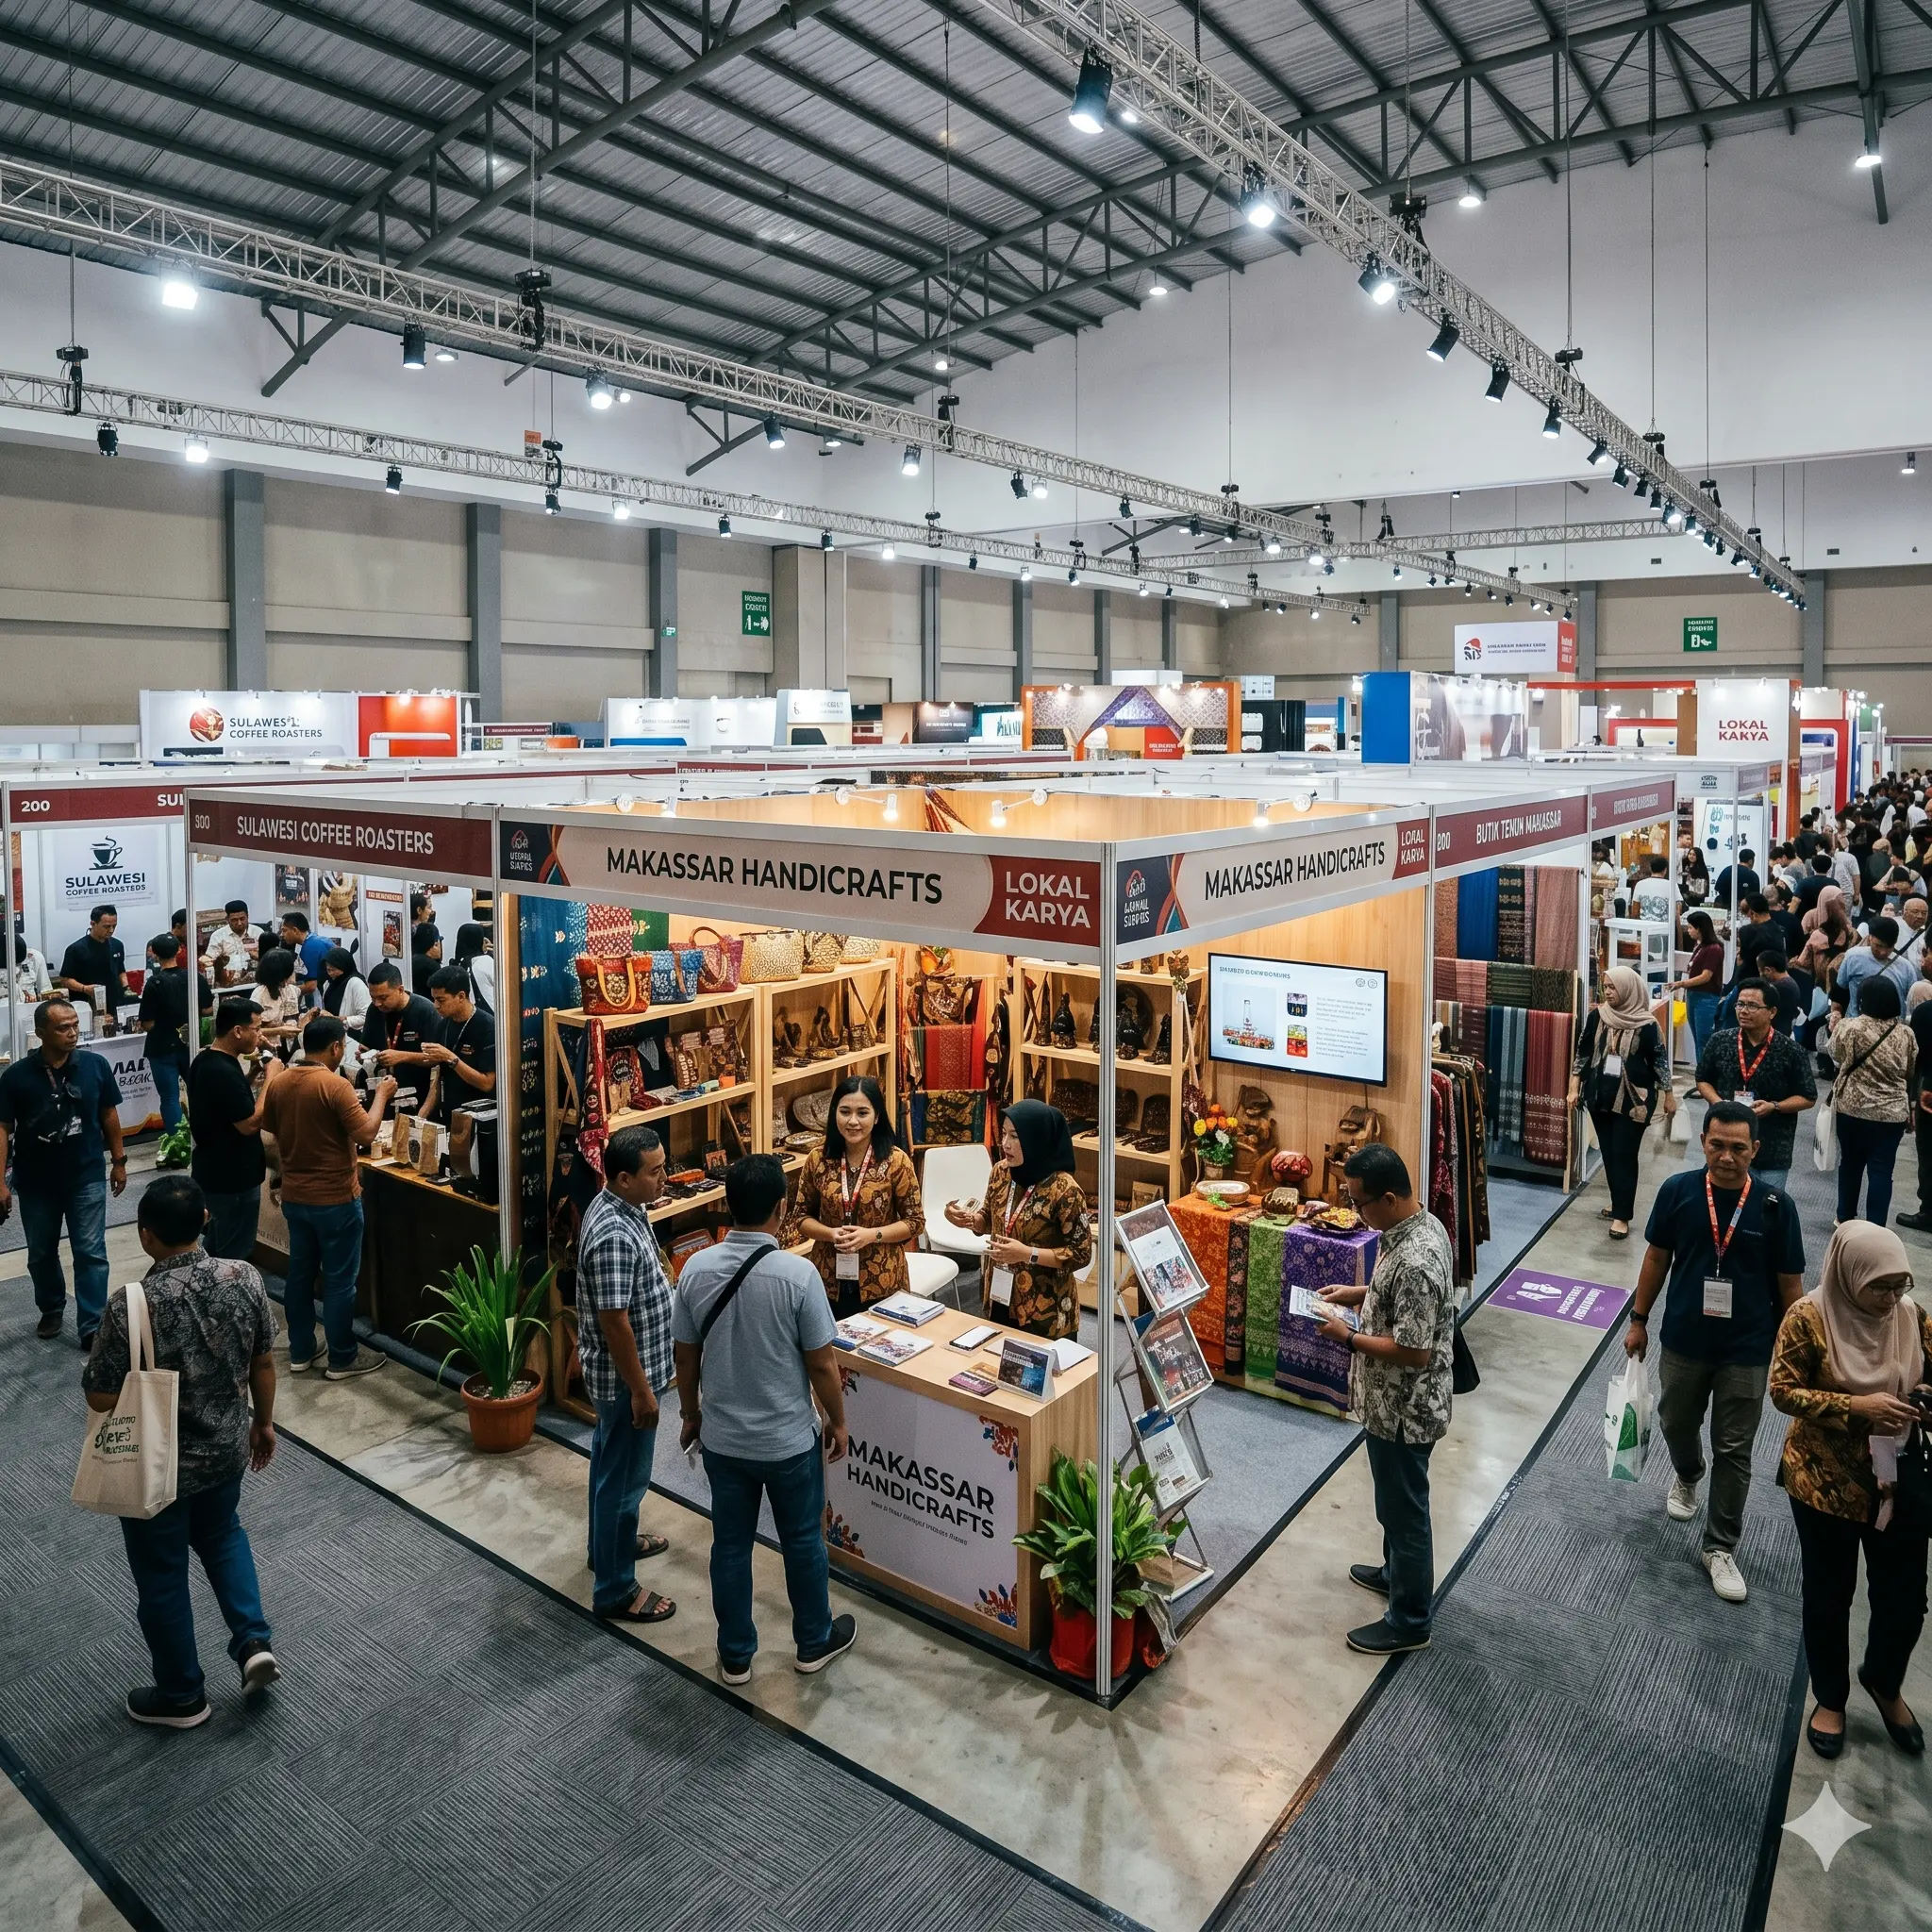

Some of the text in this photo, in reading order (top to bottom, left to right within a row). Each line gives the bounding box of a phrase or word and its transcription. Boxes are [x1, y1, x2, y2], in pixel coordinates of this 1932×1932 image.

[229, 729, 323, 739] COFFEE ROASTERS
[1719, 720, 1768, 730] LOKAL
[21, 800, 51, 812] 200
[237, 815, 298, 841] SULAWESI
[301, 822, 352, 846] COFFEE
[356, 825, 434, 855] ROASTERS
[1475, 821, 1500, 844] BUTIK
[1400, 846, 1425, 866] KARYA
[65, 872, 145, 889] SULAWESI
[607, 846, 942, 906] MAKASSAR HANDICRAFTS
[1006, 871, 1091, 900] LOKAL
[1204, 841, 1386, 901] MAKASSAR HANDICRAFTS
[1005, 898, 1091, 929] KARYA
[847, 1435, 995, 1515] MAKASSAR
[847, 1463, 995, 1540] HANDICRAFTS
